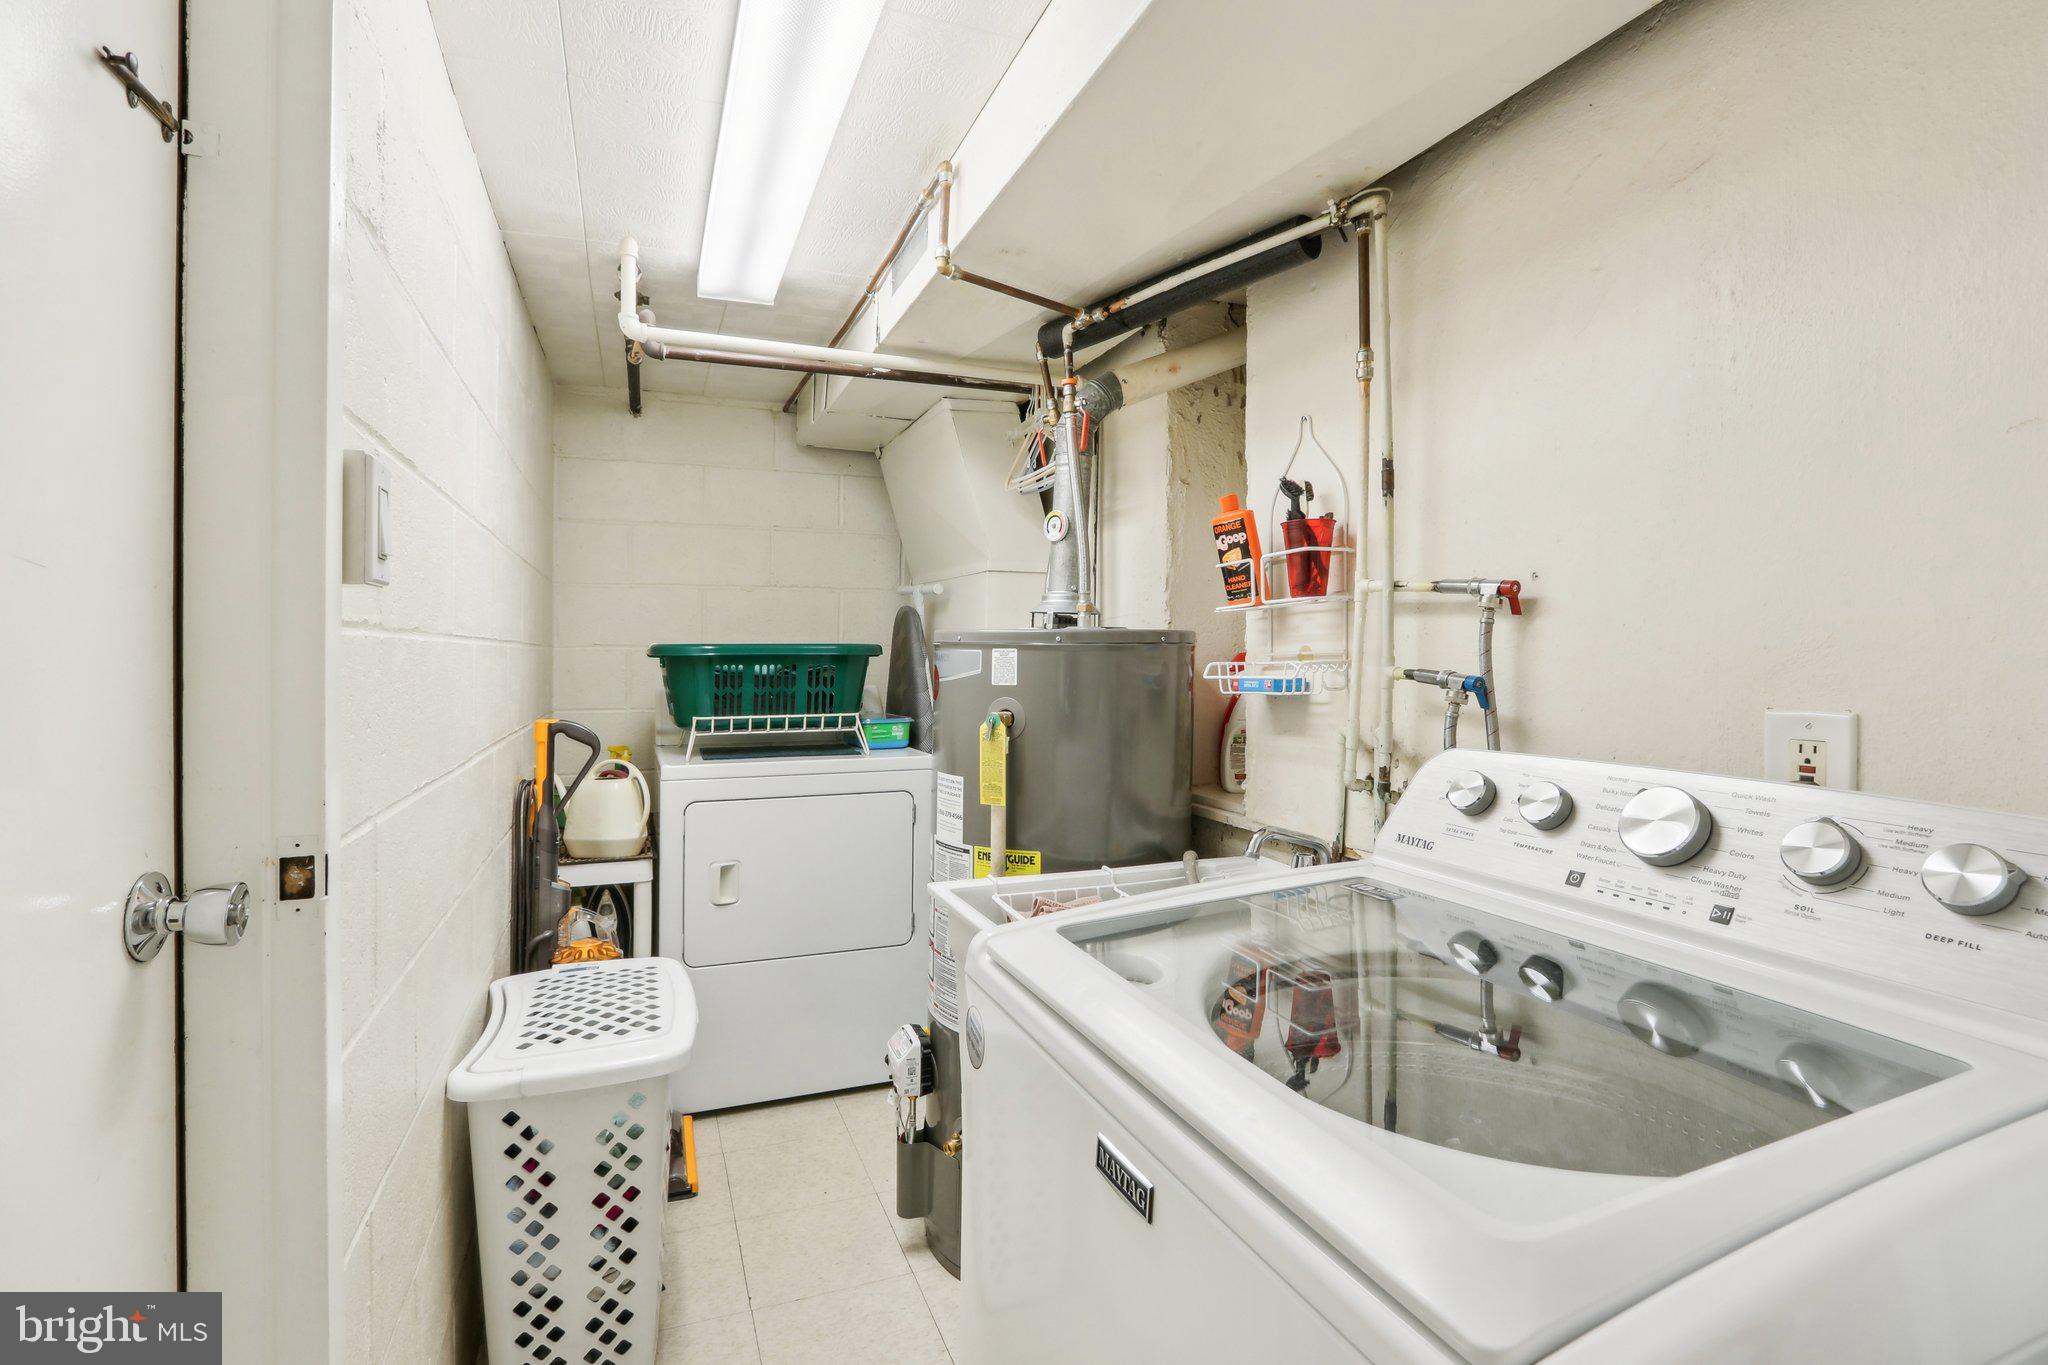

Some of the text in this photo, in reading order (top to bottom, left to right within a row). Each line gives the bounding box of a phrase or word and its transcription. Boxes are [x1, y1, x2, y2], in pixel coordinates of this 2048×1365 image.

[1214, 521, 1241, 534] ORANGE
[1227, 574, 1246, 583] HAND
[1731, 791, 1777, 803] Quick Wash
[1744, 807, 1772, 818] Towels
[1587, 823, 1612, 833] Casuals
[1736, 826, 1765, 837] Whites
[1906, 824, 1935, 834] Heavy
[1395, 833, 1435, 851] MAYTAG
[1580, 840, 1598, 850] Drain
[1603, 845, 1617, 855] Spin
[1895, 838, 1929, 849] Medium
[1513, 842, 1554, 855] TEMPERATURE
[1728, 849, 1755, 860] Colors
[1576, 851, 1616, 867] Water Faucet
[1703, 866, 1748, 881] Heavy Duty
[1891, 866, 1919, 877] Heavy
[1690, 875, 1743, 892] Clean Washer
[1876, 888, 1911, 902] Medium
[1793, 903, 1816, 914] SOIL
[1883, 907, 1905, 918] Light
[1925, 932, 1982, 951] DEEP FILL
[1098, 1145, 1146, 1211] MAYTAG
